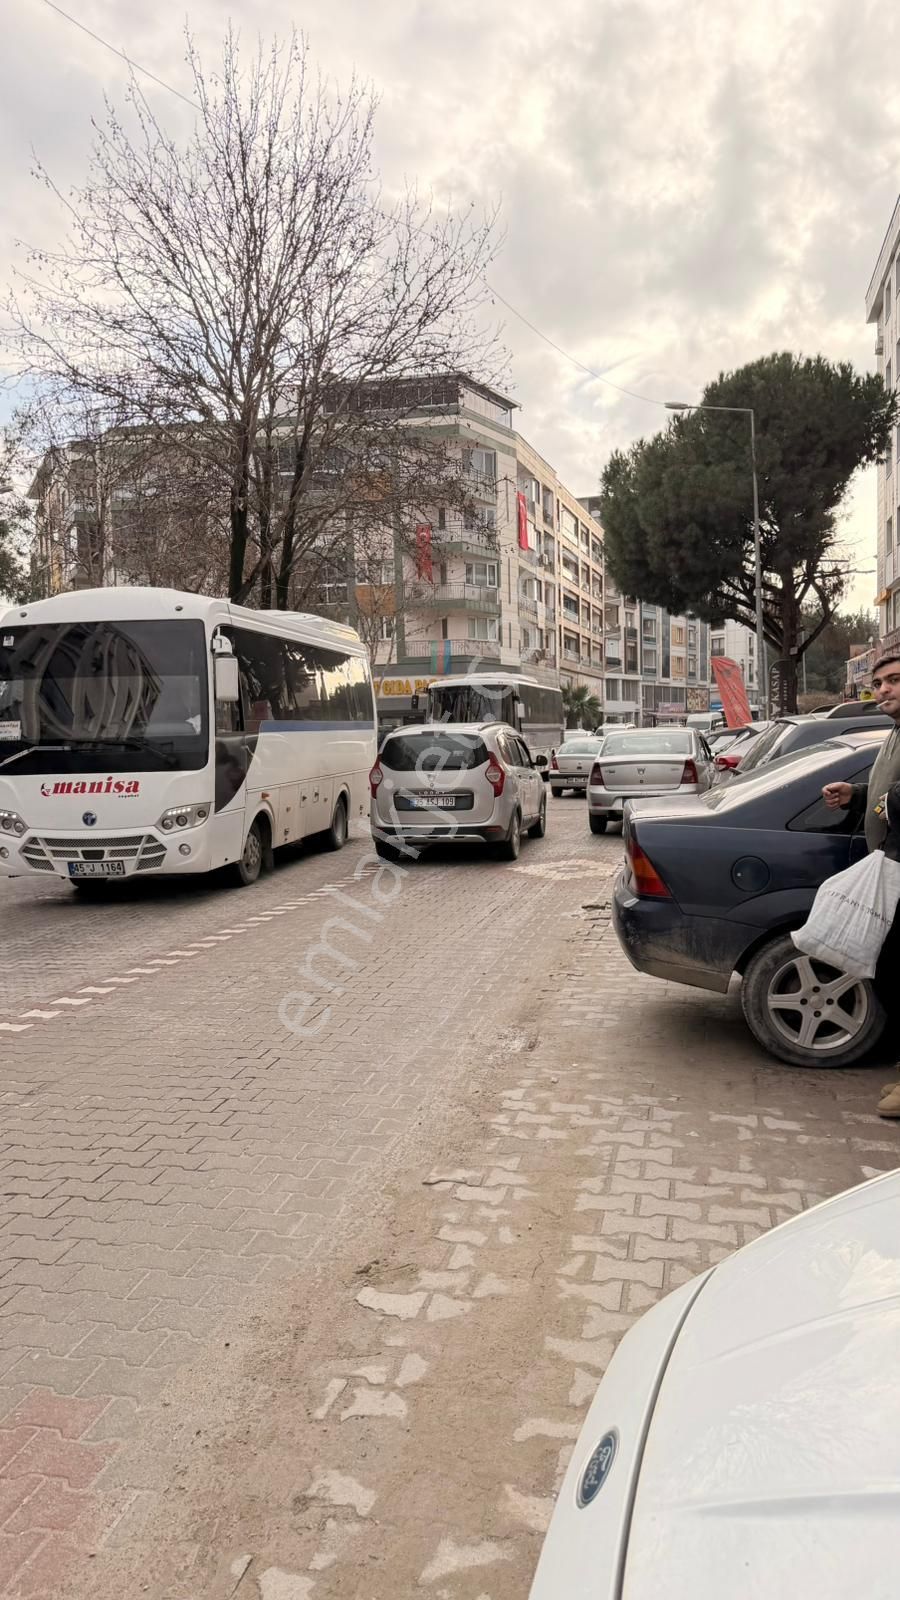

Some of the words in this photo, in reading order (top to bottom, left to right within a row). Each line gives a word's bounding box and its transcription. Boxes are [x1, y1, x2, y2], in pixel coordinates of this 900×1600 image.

[383, 679, 412, 696] GIDA
[771, 667, 781, 702] KASAP
[52, 776, 140, 794] manisa
[441, 797, 454, 806] 109
[75, 863, 85, 873] 45
[90, 863, 95, 873] J
[100, 863, 122, 872] 1164
[584, 1446, 612, 1488] Ford
